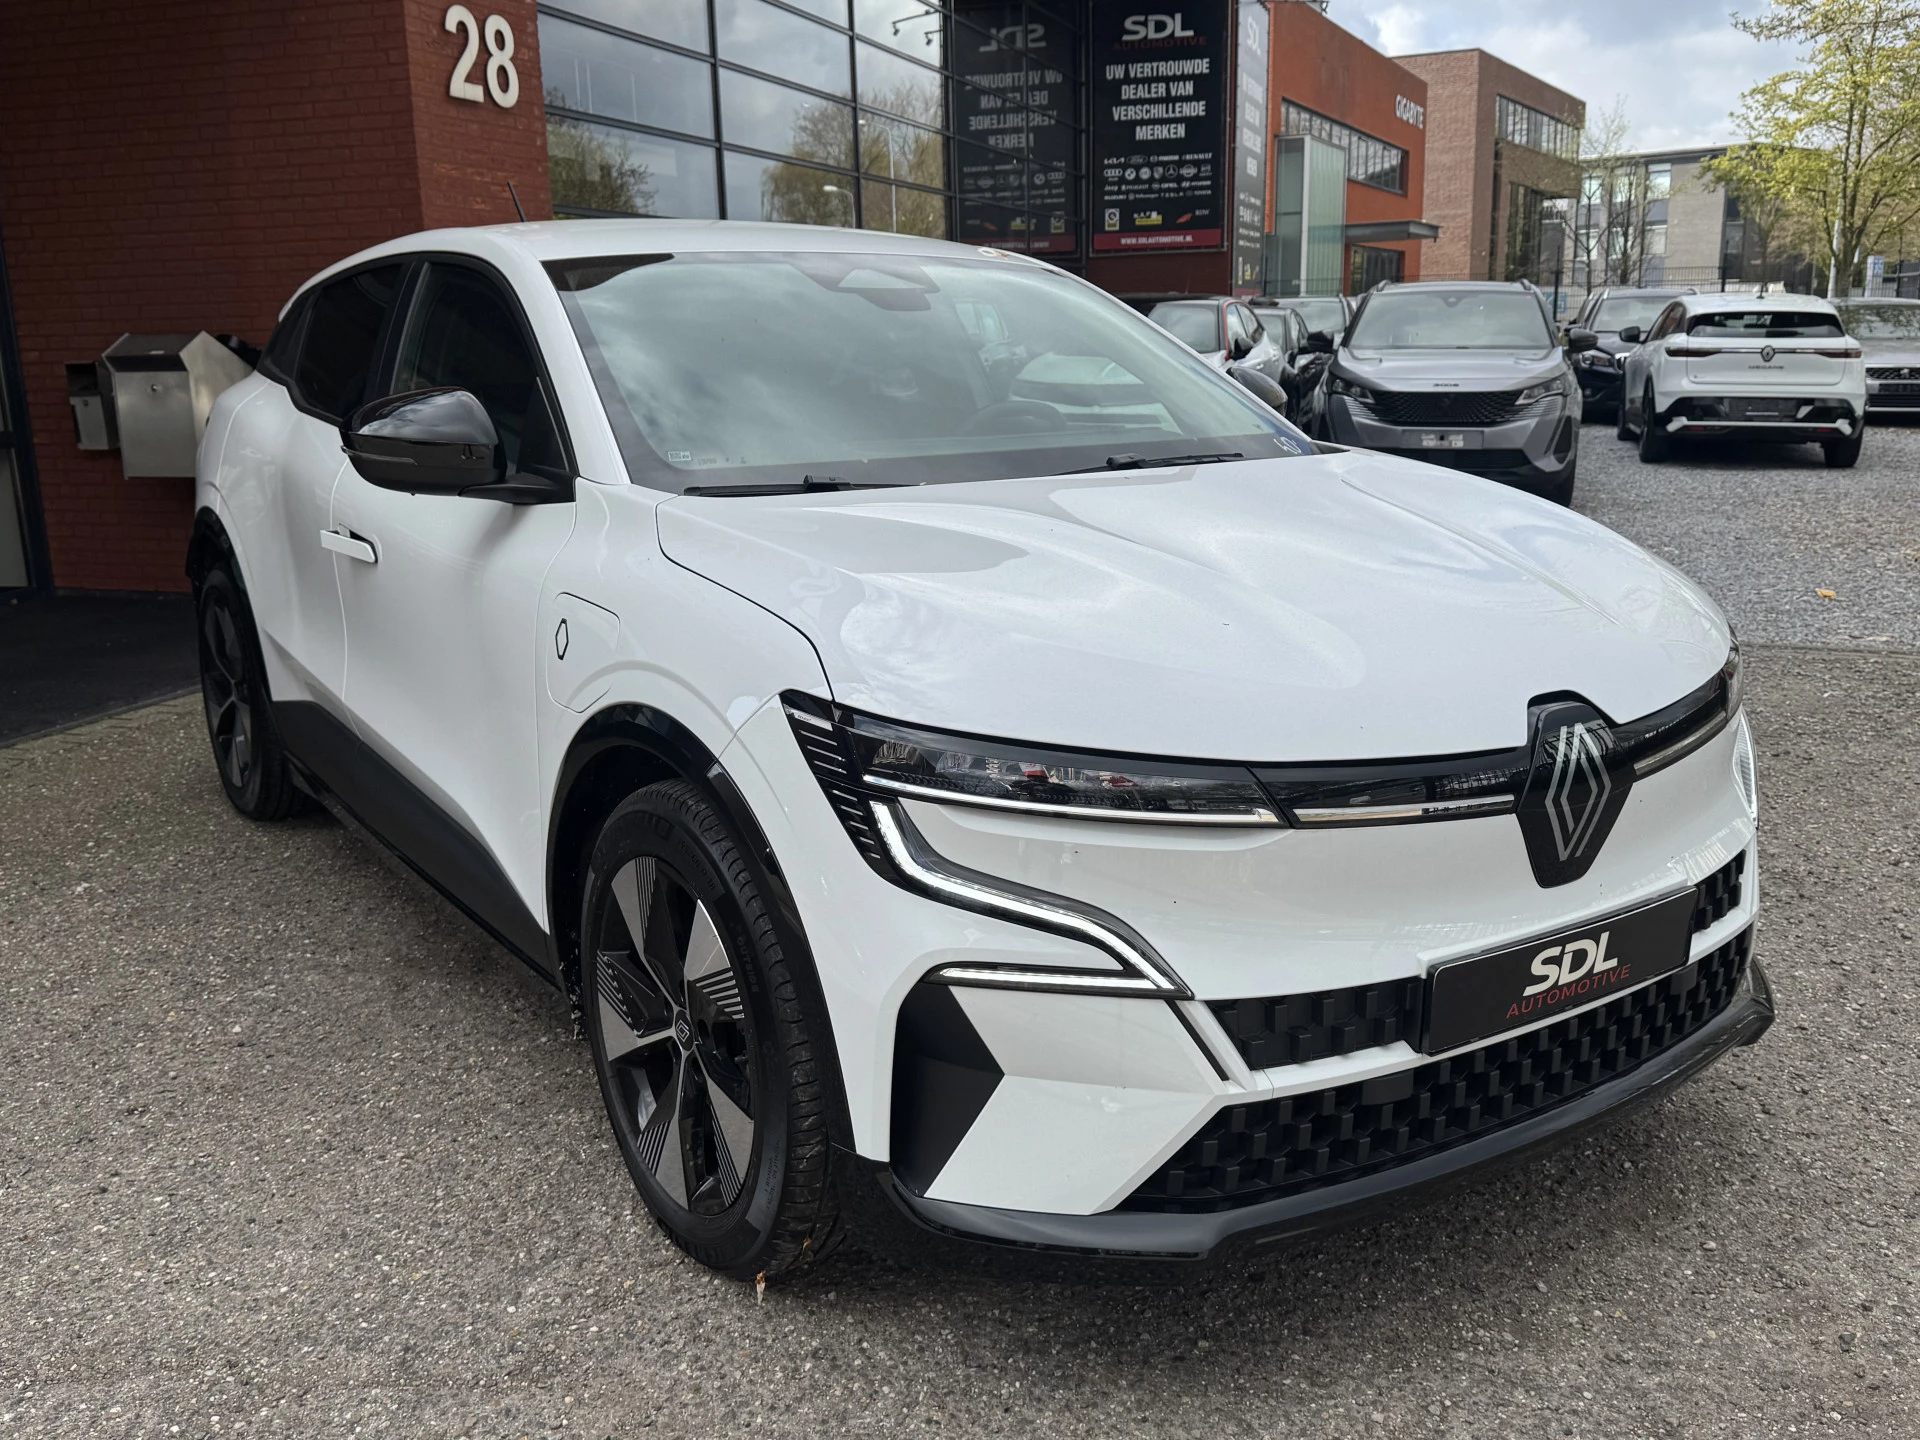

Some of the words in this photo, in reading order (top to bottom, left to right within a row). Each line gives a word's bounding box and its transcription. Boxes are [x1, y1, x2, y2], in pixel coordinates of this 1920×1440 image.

[1121, 12, 1195, 41] SDL
[1112, 36, 1208, 50] AUTOMOTIVE
[445, 4, 519, 108] 28
[1105, 63, 1126, 80] UW
[1128, 58, 1211, 78] VERTROUWDE
[1121, 82, 1167, 100] DEALER
[1169, 80, 1195, 98] VAN
[1112, 100, 1207, 121] VERSCHILLENDE
[1135, 122, 1186, 141] MERKEN
[736, 935, 761, 993] OUTSIDE
[1522, 931, 1618, 997] SDL
[1506, 964, 1631, 1019] AUTOMOTIVE
